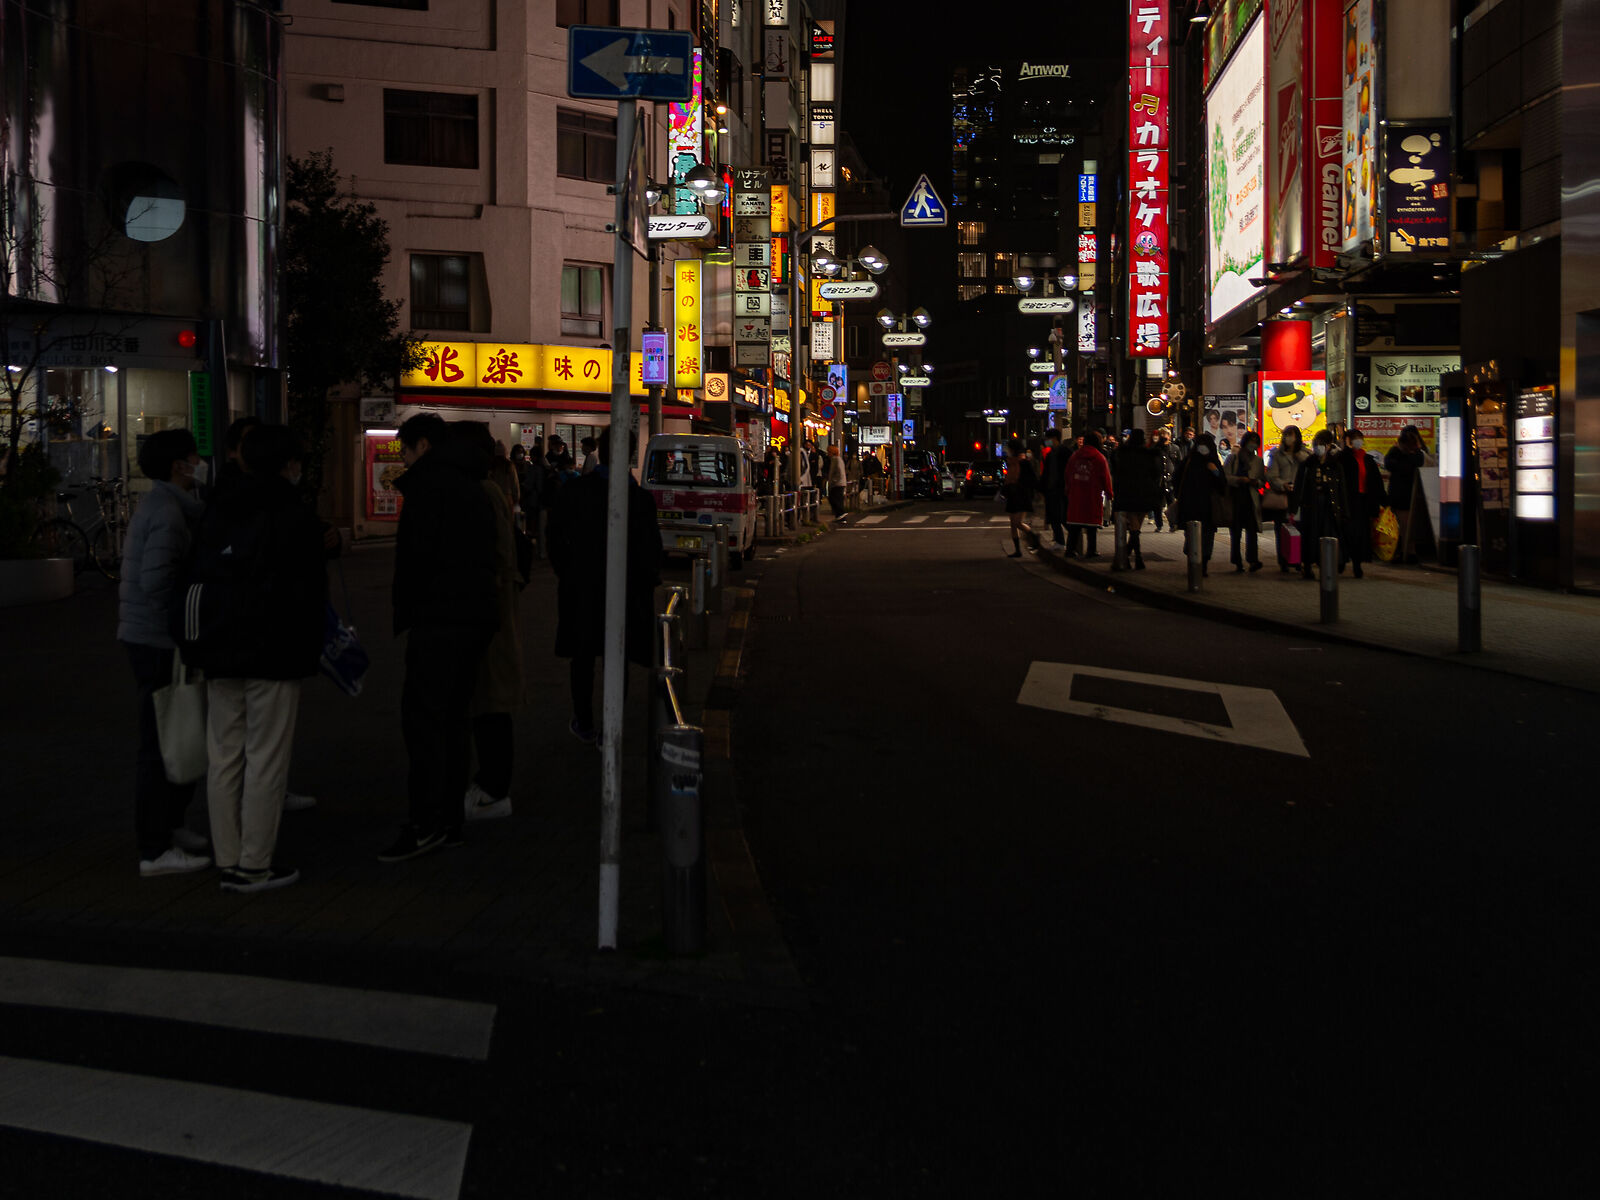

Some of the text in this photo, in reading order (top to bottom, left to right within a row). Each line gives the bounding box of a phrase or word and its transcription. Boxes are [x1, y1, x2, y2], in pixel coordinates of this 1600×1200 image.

[1020, 62, 1069, 77] Amway
[1136, 121, 1161, 228] カラオケ
[1321, 162, 1342, 253] Game!
[424, 346, 601, 384] 兆楽 味の
[677, 268, 700, 375] 味の兆楽
